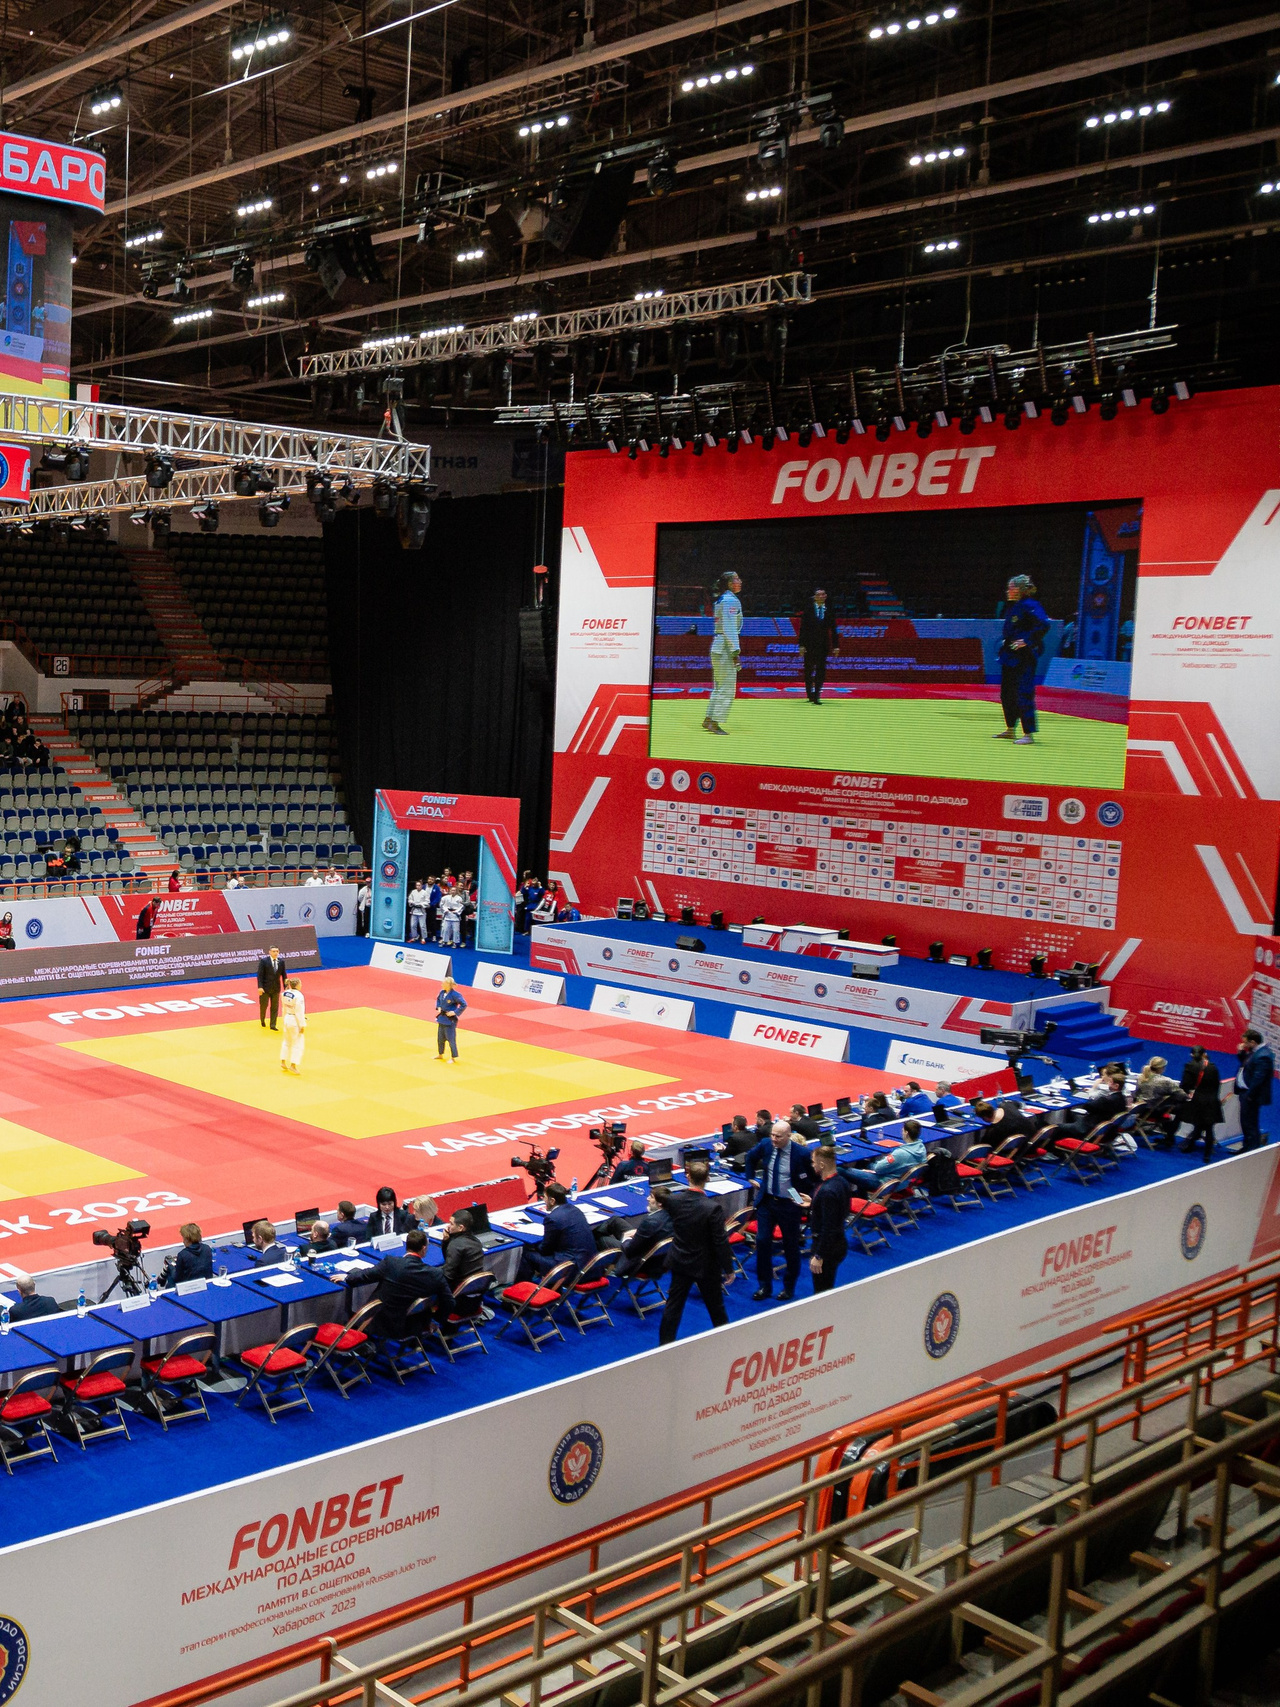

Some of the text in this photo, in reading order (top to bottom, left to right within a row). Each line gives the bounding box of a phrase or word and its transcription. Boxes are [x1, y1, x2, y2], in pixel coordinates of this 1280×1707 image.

[772, 446, 976, 504] FONBET
[582, 618, 627, 629] FONBET
[1172, 616, 1252, 630] FONBET
[56, 659, 67, 672] 26
[759, 783, 969, 806] МЕЖДУНАРОДНЫЕ СОРЕВНОВАНИЯ ДЗЮДО
[833, 775, 887, 789] FONBET
[406, 805, 451, 819] ДЗЮДО
[421, 795, 458, 806] FONBET
[33, 951, 232, 975] МЕЖДУНАРОДНЫЕ СОРЕВНОВАНИЯ ДЗЮДО СРЕДИ МУЖЧИН
[135, 945, 171, 957] FONBET
[627, 948, 655, 958] FONBET
[694, 959, 724, 970] FONBET
[25, 973, 55, 984] ПАМЯТИ
[124, 965, 146, 974] СЕРИИ
[146, 960, 213, 972] ПРОФЕССИОНАЛЬНЫХ
[213, 955, 258, 966] СОРЕВНОВАНИЙ
[129, 972, 166, 981] ХАБАРОВСК
[767, 971, 798, 983] FONBET
[844, 984, 878, 996] FONBET
[49, 992, 256, 1026] FONBET
[1153, 1002, 1211, 1019] FONBET
[754, 1024, 822, 1048] FONBET
[908, 1057, 924, 1065] СМП
[403, 1089, 734, 1157] ХАБАРОВСК 2023
[45, 1190, 191, 1227] 2023
[1041, 1225, 1117, 1277] FONBET
[725, 1325, 834, 1395] FONBET
[695, 1353, 856, 1421] МЕЖДУНАРОДНЫЕ СОРЕВНОВАНИЯ
[753, 1387, 802, 1414] ПО ДЗЮДО
[740, 1400, 811, 1432] ПАМЯТИ ОЩЕПКОВА
[574, 1424, 599, 1441] ДЗЮДО
[550, 1433, 572, 1496] ФЕДЕРАЦИЯ
[589, 1440, 603, 1484] РОССИИ
[228, 1474, 404, 1570] FONBET
[181, 1505, 440, 1606] МЕЖДУНАРОДНЫЕ СОРЕВНОВАНИЯ
[277, 1552, 355, 1590] ПО ДЗЮДО
[257, 1567, 371, 1614] ПАМЯТИ ОЩЕПКОВА
[180, 1582, 364, 1654] этап серии профессиональных соревнований
[272, 1597, 356, 1638] Хабаровск 2023
[7, 1637, 26, 1692] РОССИИ
